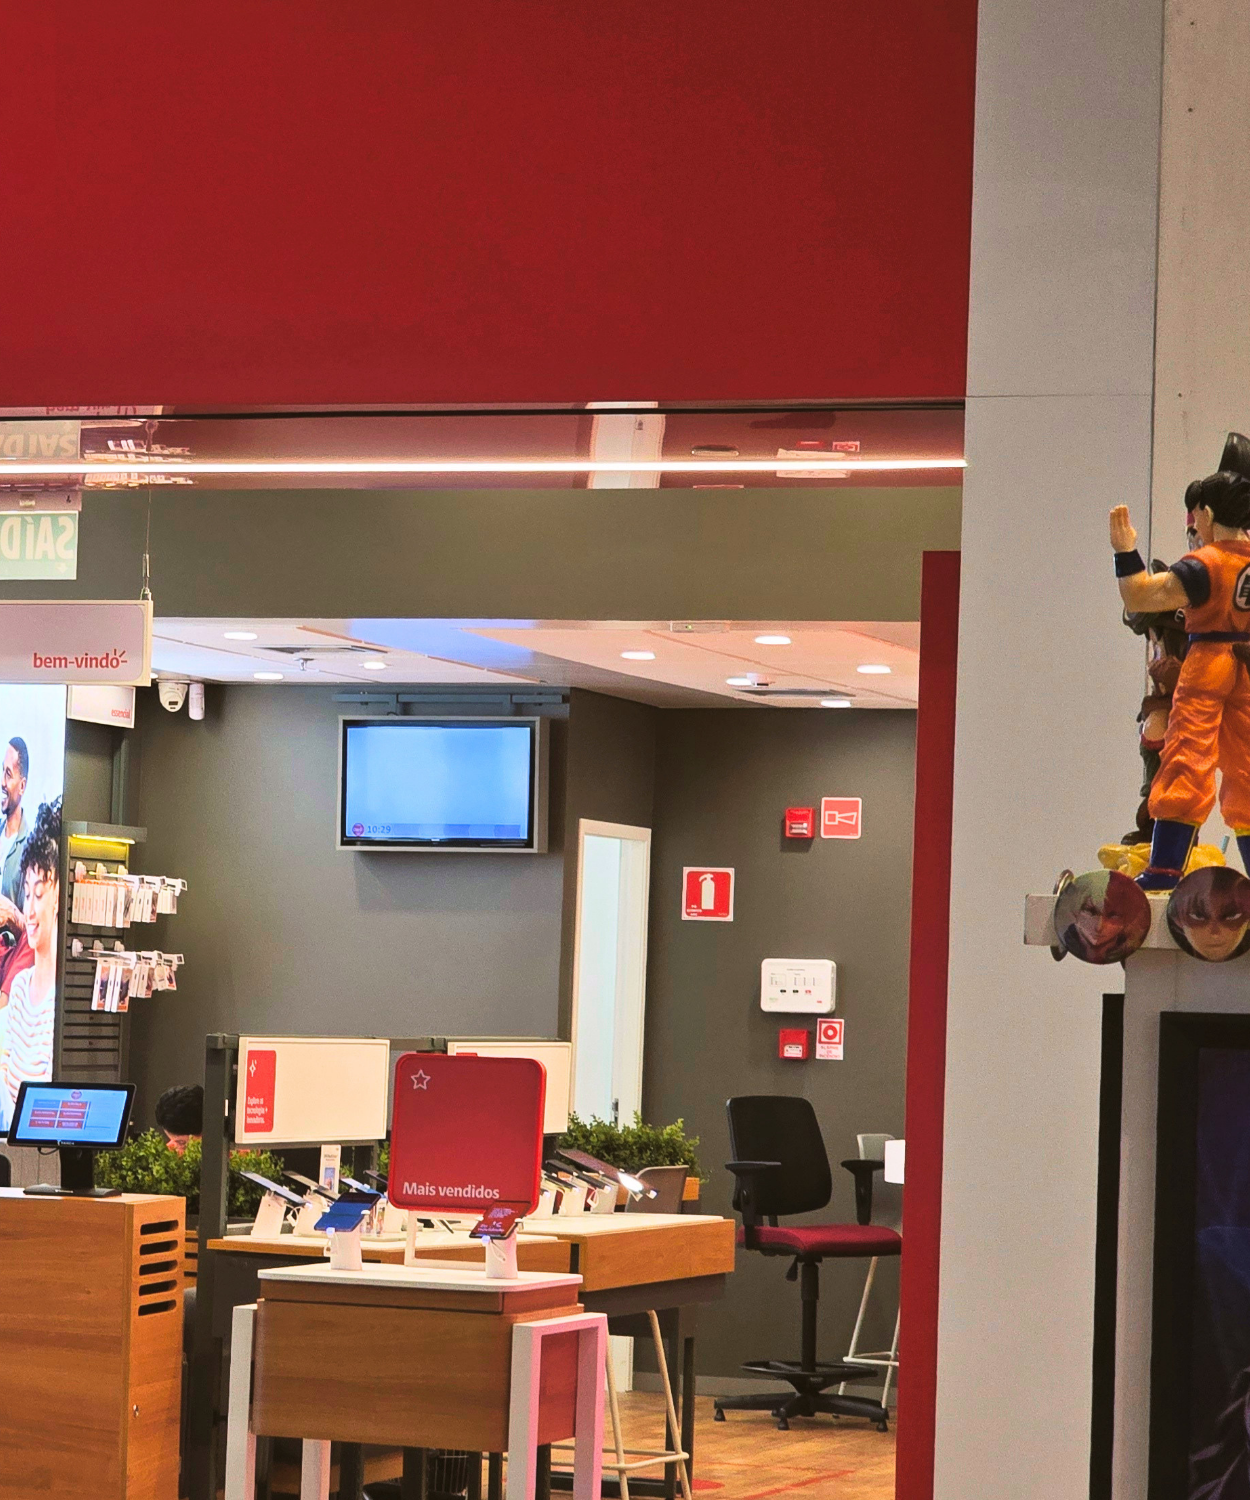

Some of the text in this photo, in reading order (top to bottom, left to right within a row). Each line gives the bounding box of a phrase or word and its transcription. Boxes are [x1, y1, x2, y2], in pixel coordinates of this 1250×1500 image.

[33, 652, 121, 669] bem-vindo
[367, 825, 392, 834] 10:29
[403, 1182, 500, 1199] Mais vendidos
